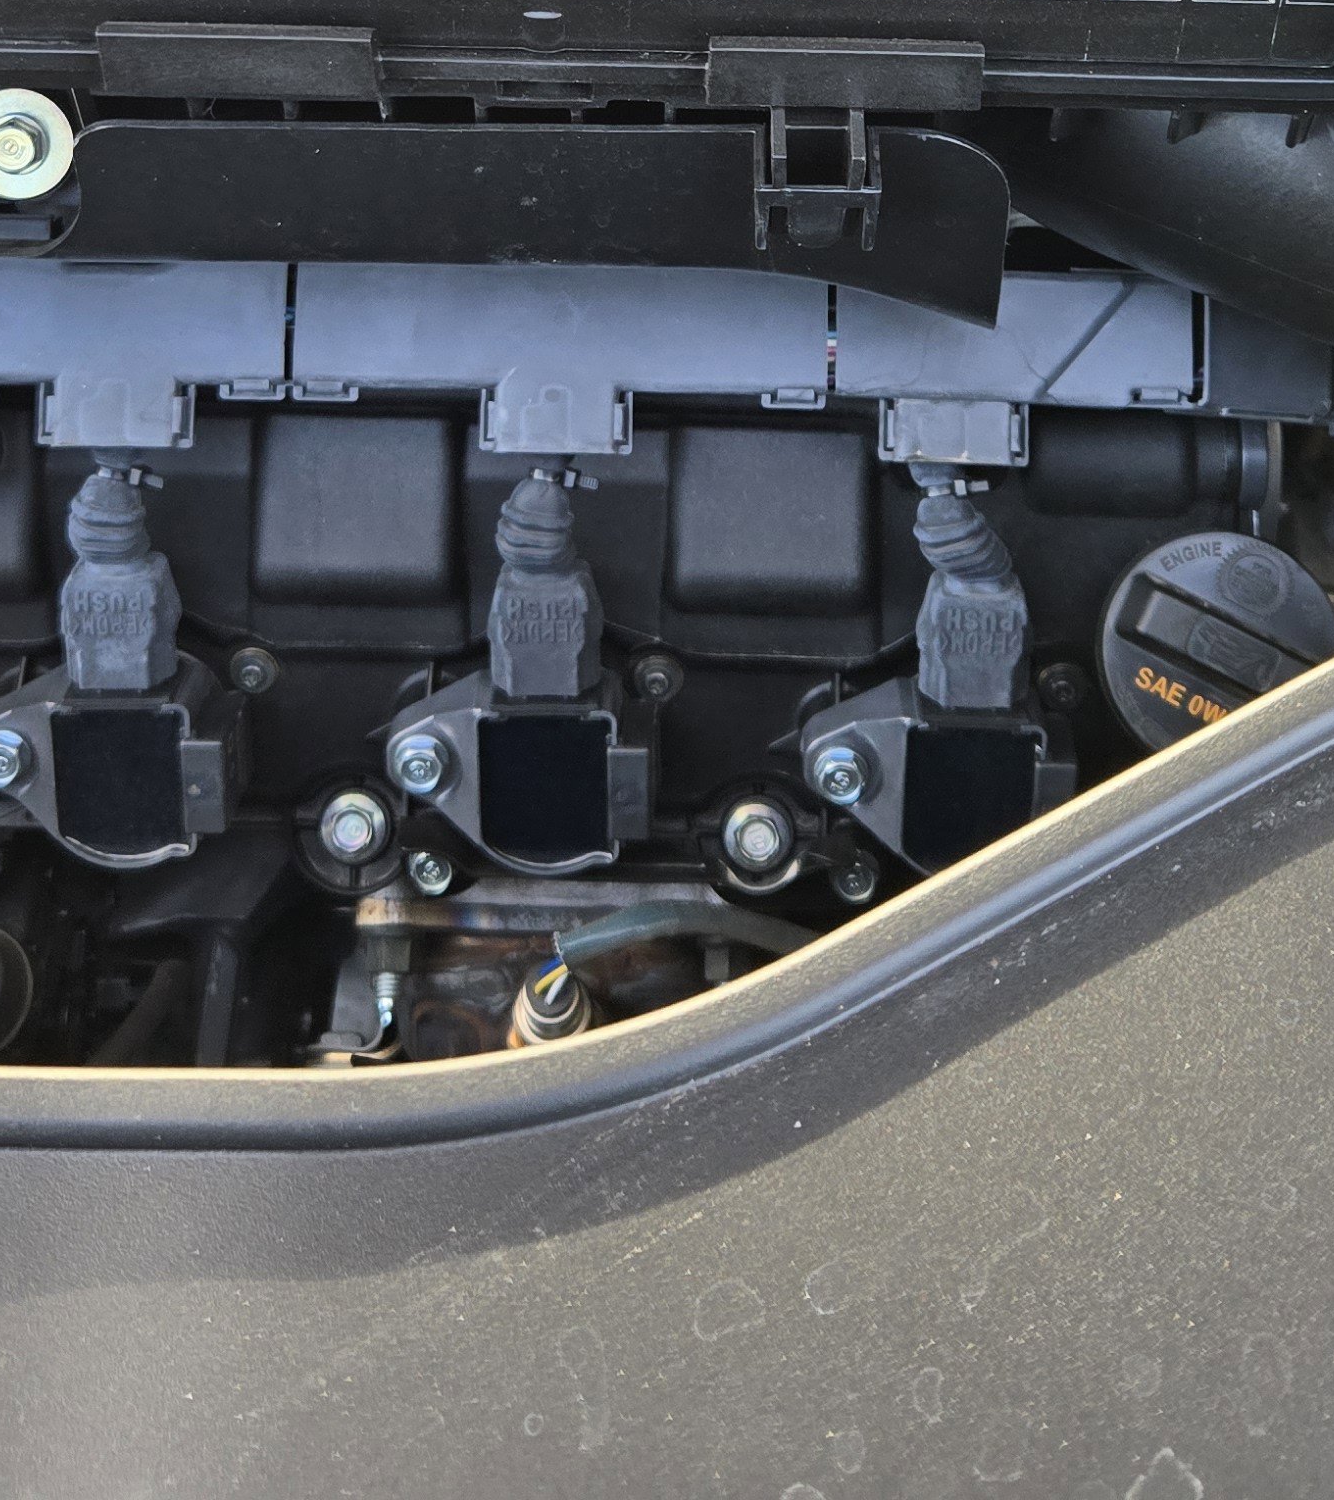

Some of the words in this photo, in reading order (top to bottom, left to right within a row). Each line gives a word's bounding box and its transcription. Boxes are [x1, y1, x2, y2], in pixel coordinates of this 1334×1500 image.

[1159, 541, 1224, 572] ENGINE
[73, 589, 145, 613] PUSH
[507, 598, 579, 620] PUSH
[946, 608, 1016, 633] PUSH
[1134, 666, 1187, 708] SAE
